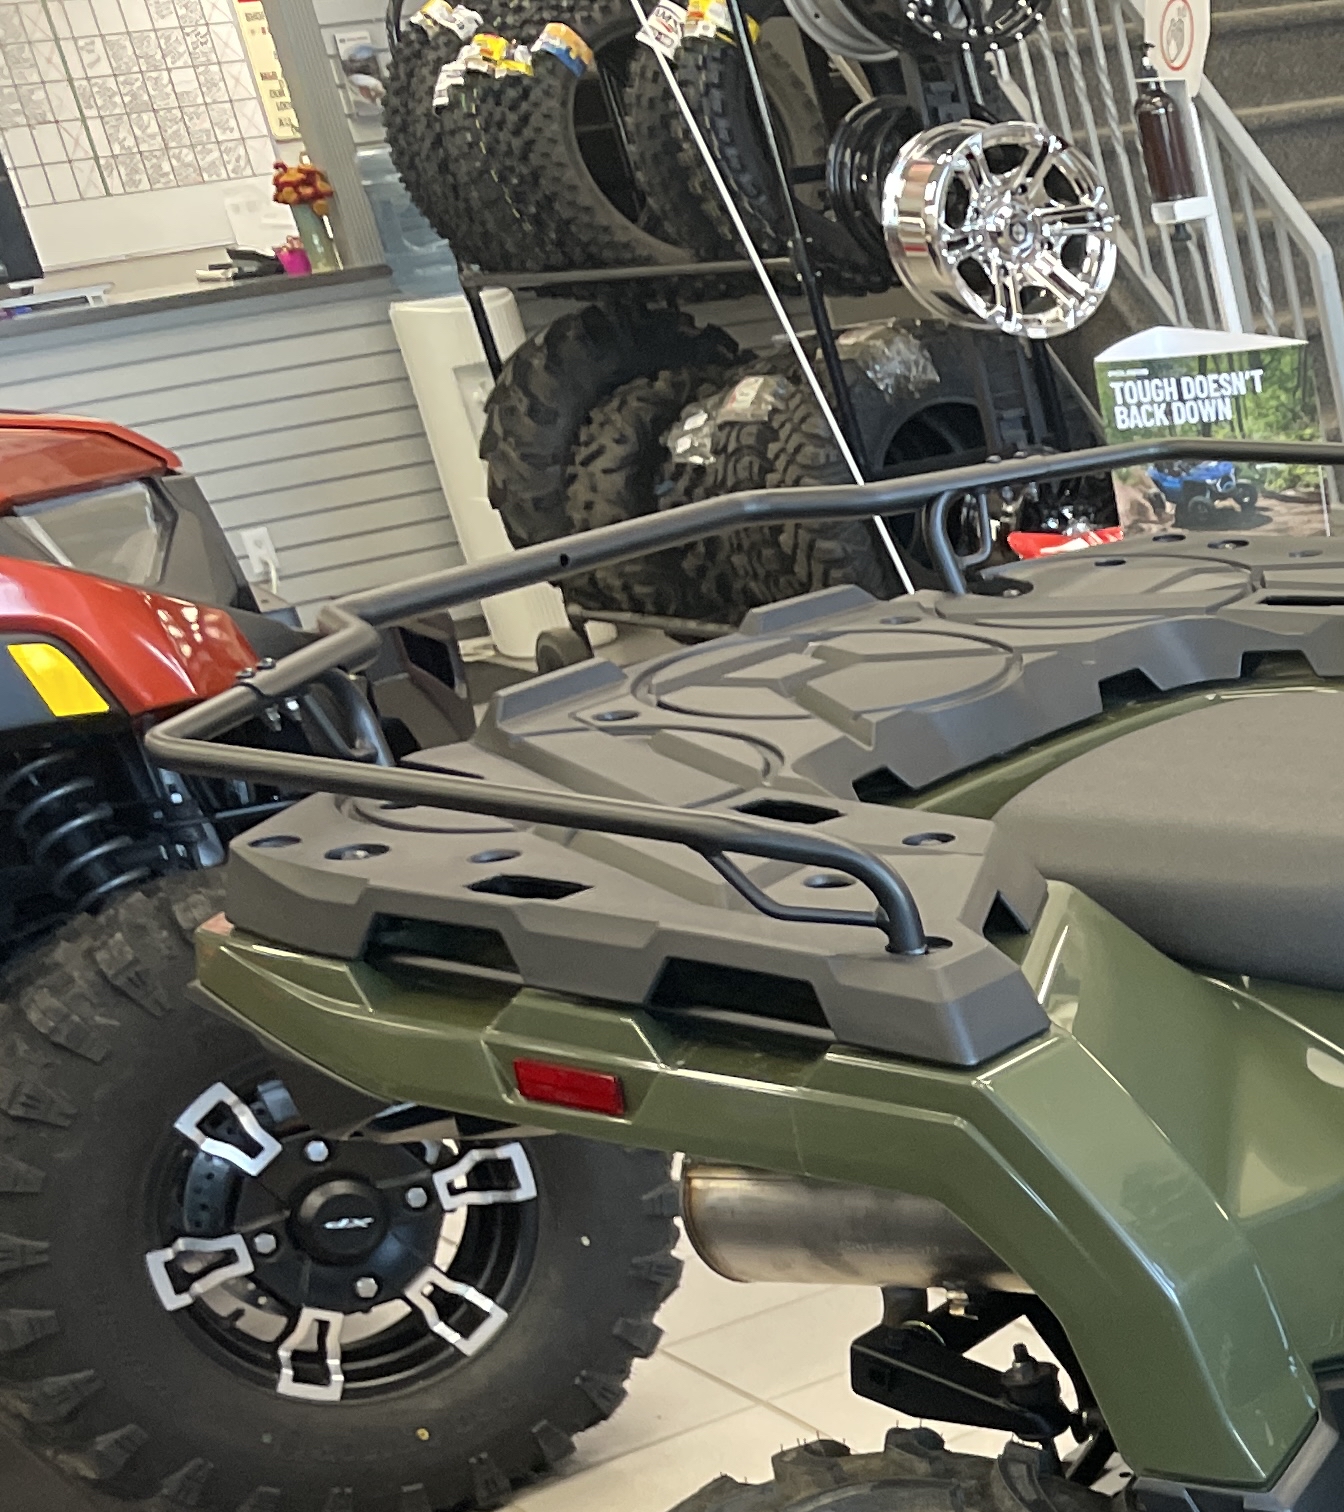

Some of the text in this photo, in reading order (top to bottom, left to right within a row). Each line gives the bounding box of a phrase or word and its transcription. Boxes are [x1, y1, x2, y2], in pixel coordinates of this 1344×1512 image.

[1109, 369, 1264, 405] TOUGH DOESN'T
[1114, 397, 1233, 431] BACK DOWN
